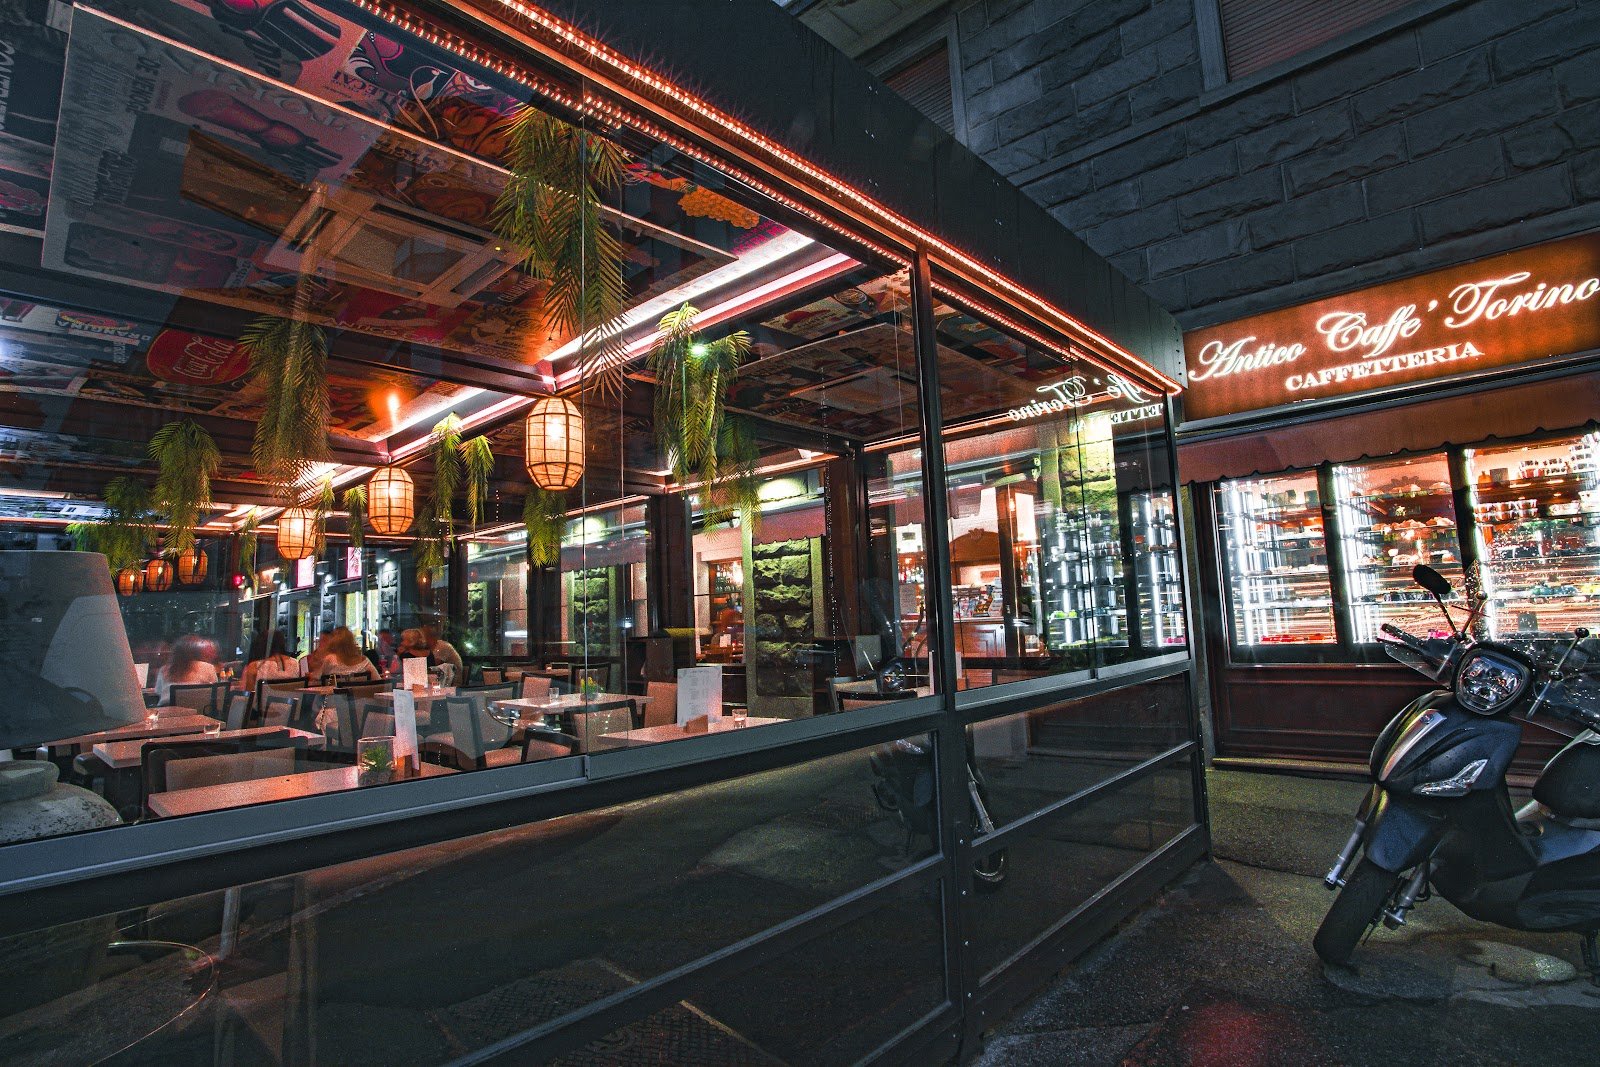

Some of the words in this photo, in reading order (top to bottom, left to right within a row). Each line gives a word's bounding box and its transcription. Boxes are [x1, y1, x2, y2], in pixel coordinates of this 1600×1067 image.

[1187, 335, 1306, 382] Antico
[1444, 271, 1600, 330] Torino
[1284, 341, 1485, 392] CAFFETTERIA
